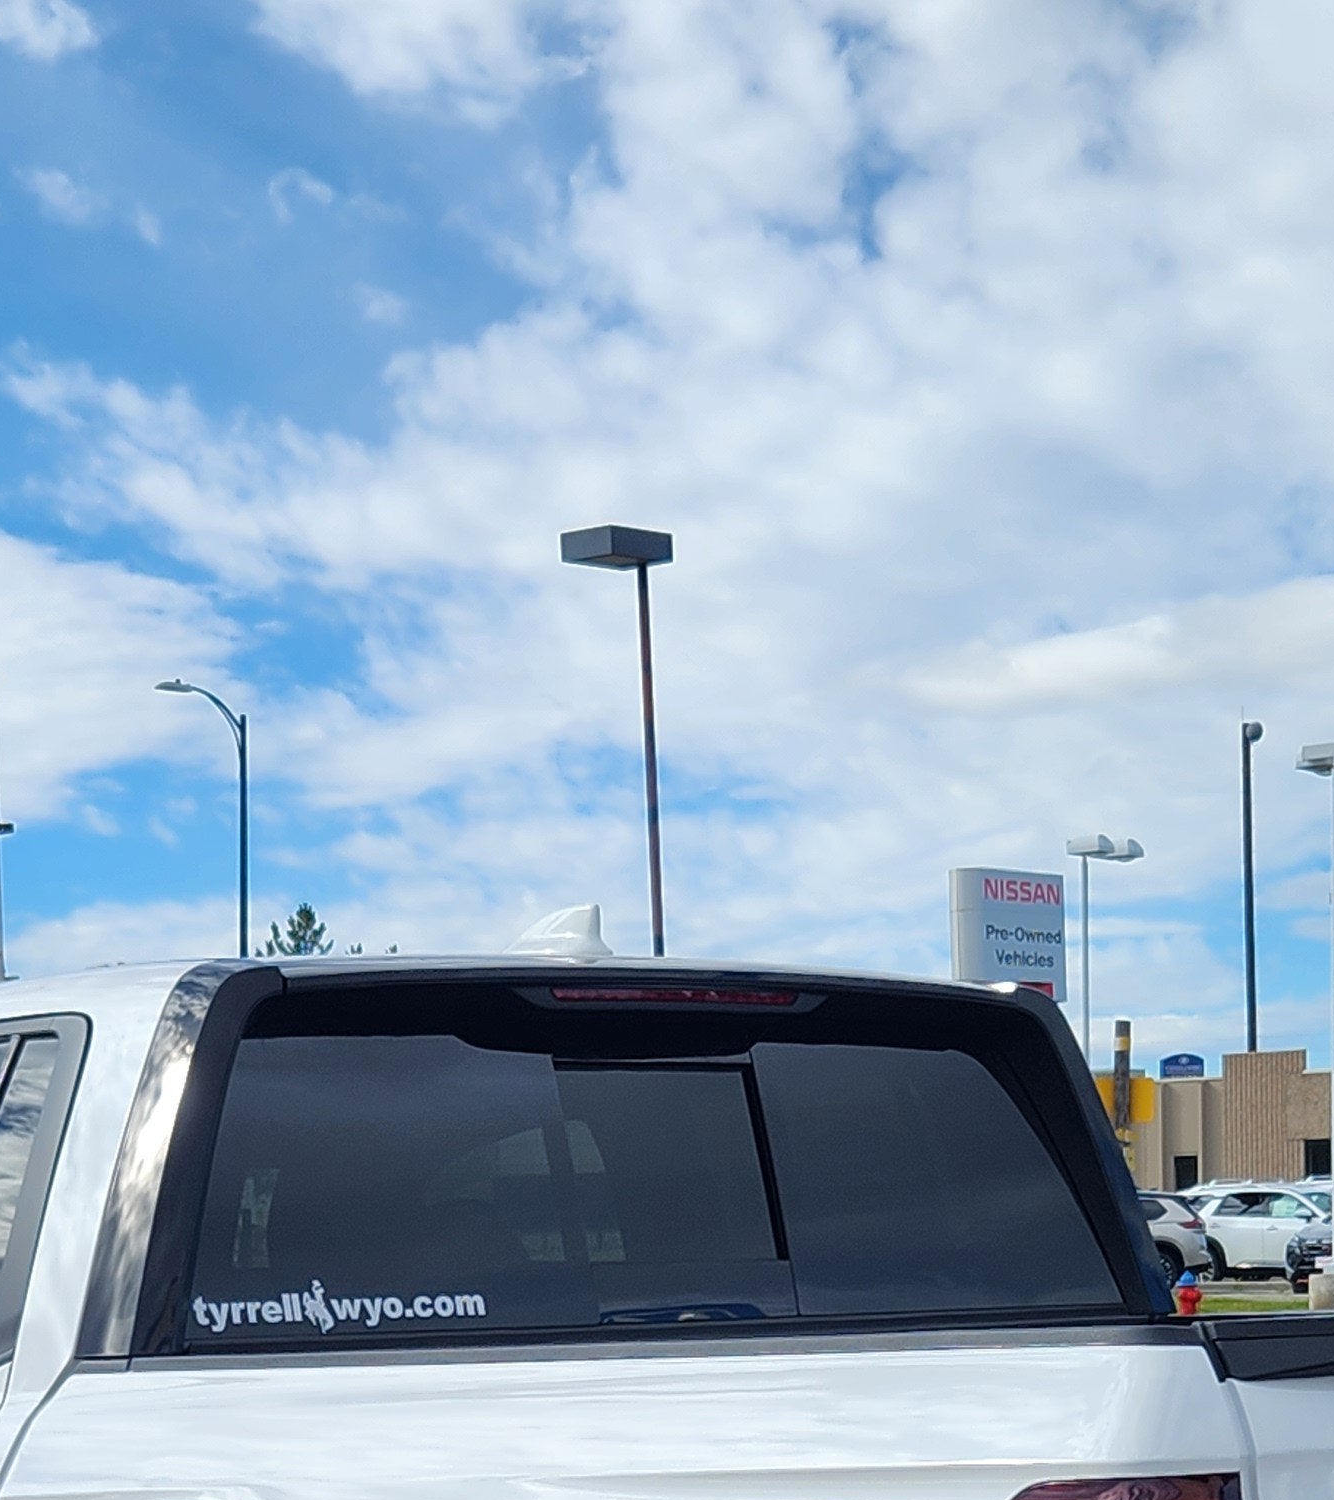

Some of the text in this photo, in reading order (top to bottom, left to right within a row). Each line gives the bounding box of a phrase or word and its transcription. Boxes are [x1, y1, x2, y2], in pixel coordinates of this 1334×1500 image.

[983, 877, 1061, 906] NISSAN
[985, 924, 1062, 945] Pre-Owned
[995, 948, 1054, 968] Vehicles
